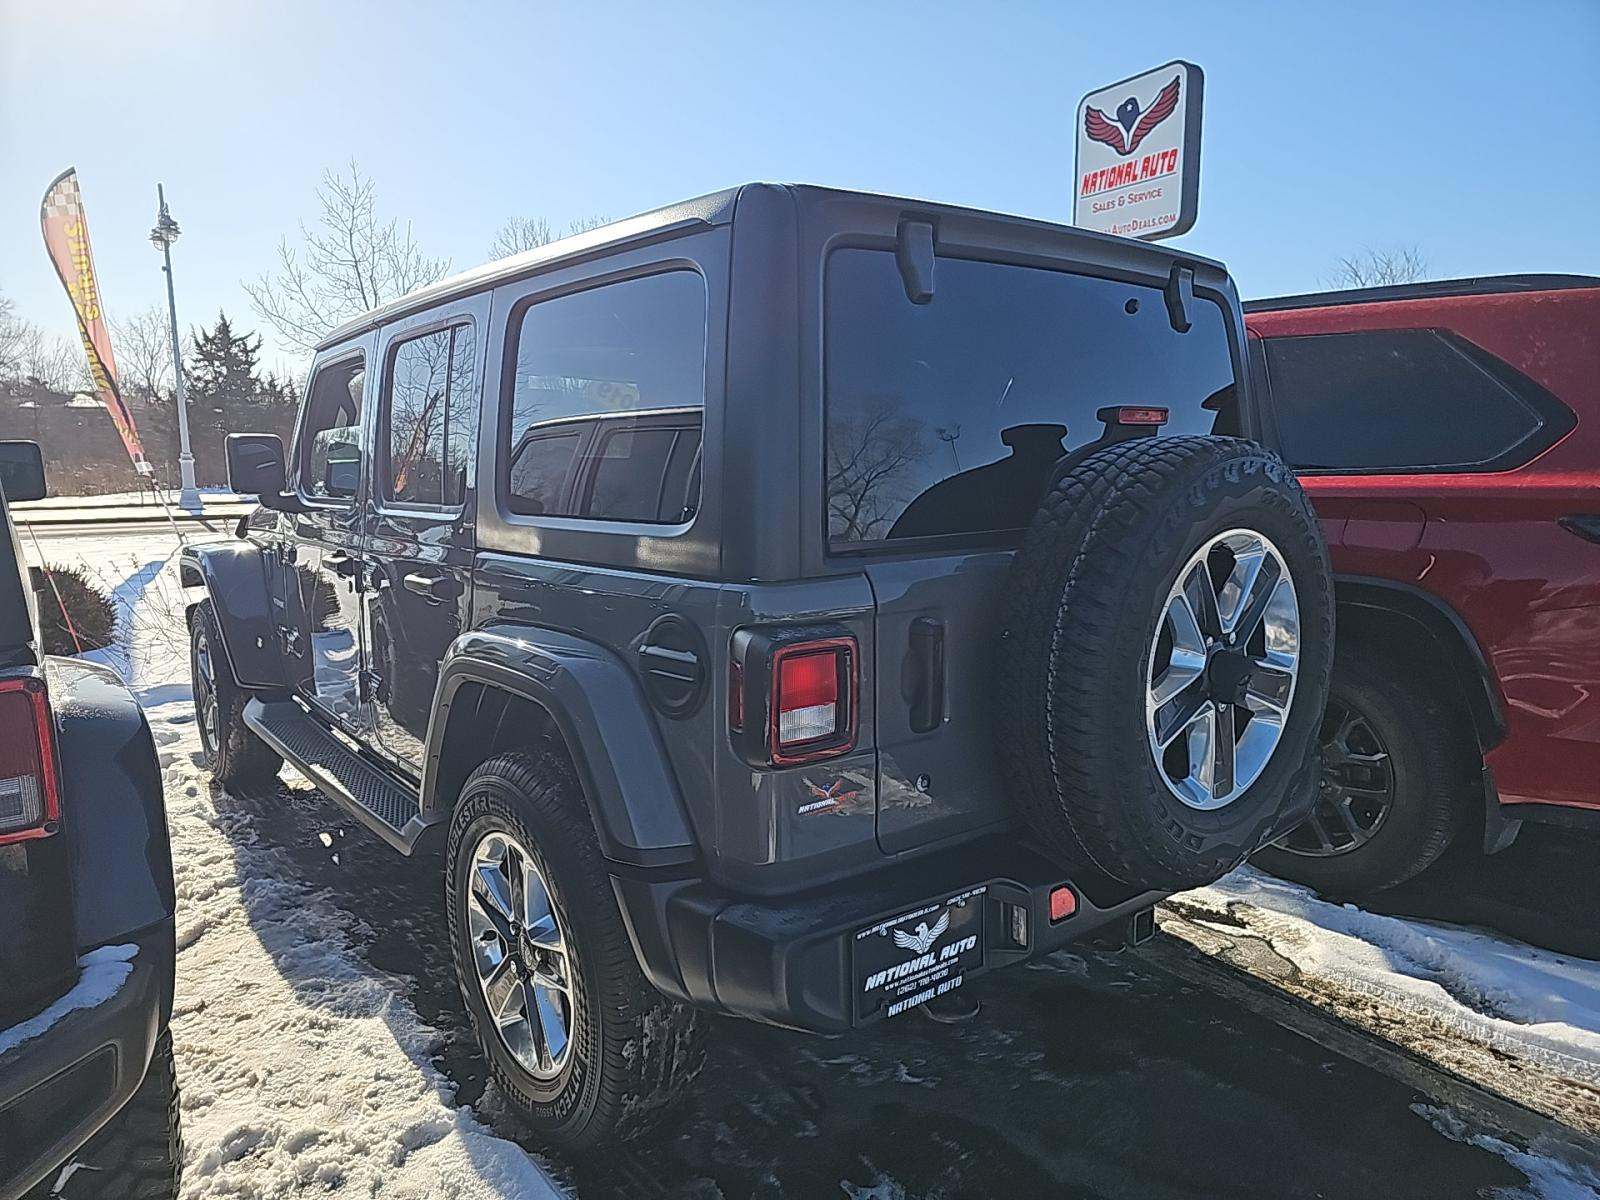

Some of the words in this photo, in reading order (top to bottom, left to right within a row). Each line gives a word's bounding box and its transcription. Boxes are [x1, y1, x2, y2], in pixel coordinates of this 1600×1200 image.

[1080, 159, 1138, 196] NATIONAL
[1140, 148, 1178, 181] AUTO
[1117, 195, 1126, 207] &
[64, 221, 101, 322] STRUTS
[864, 951, 937, 993] NATIONAL
[939, 935, 978, 961] AUTO
[887, 986, 937, 1018] NATIONAL
[937, 975, 963, 996] AUTO
